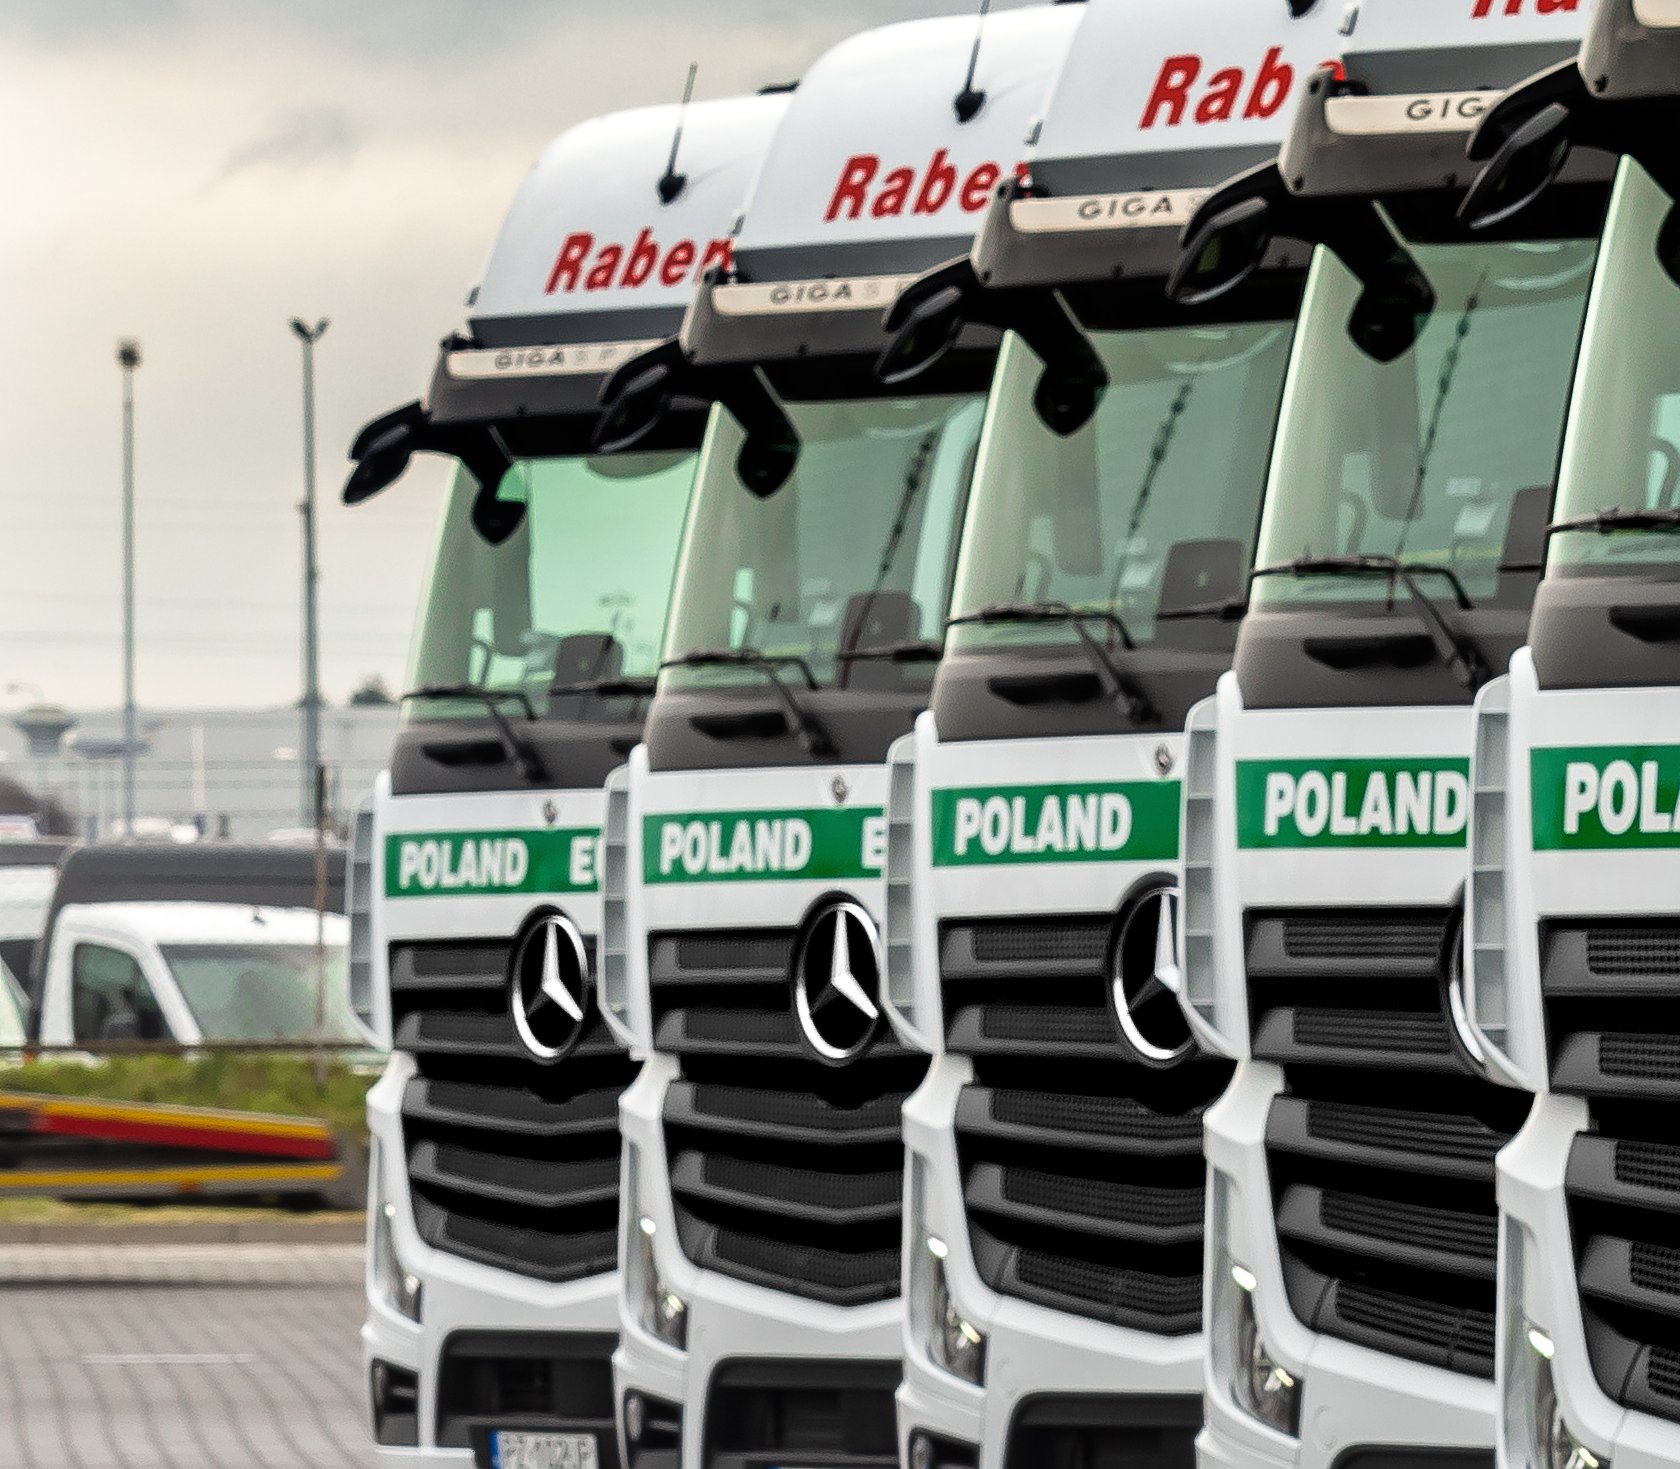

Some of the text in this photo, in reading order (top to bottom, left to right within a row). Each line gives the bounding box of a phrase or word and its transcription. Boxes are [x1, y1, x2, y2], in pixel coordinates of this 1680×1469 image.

[1140, 47, 1346, 130] Rab
[1407, 96, 1486, 121] GIG
[1078, 196, 1172, 221] GIGA
[768, 281, 852, 306] GIGA
[953, 792, 1133, 856] POLAND
[1263, 769, 1470, 838] POLAND
[399, 836, 528, 890] POLAND
[660, 819, 812, 875] POLAND
